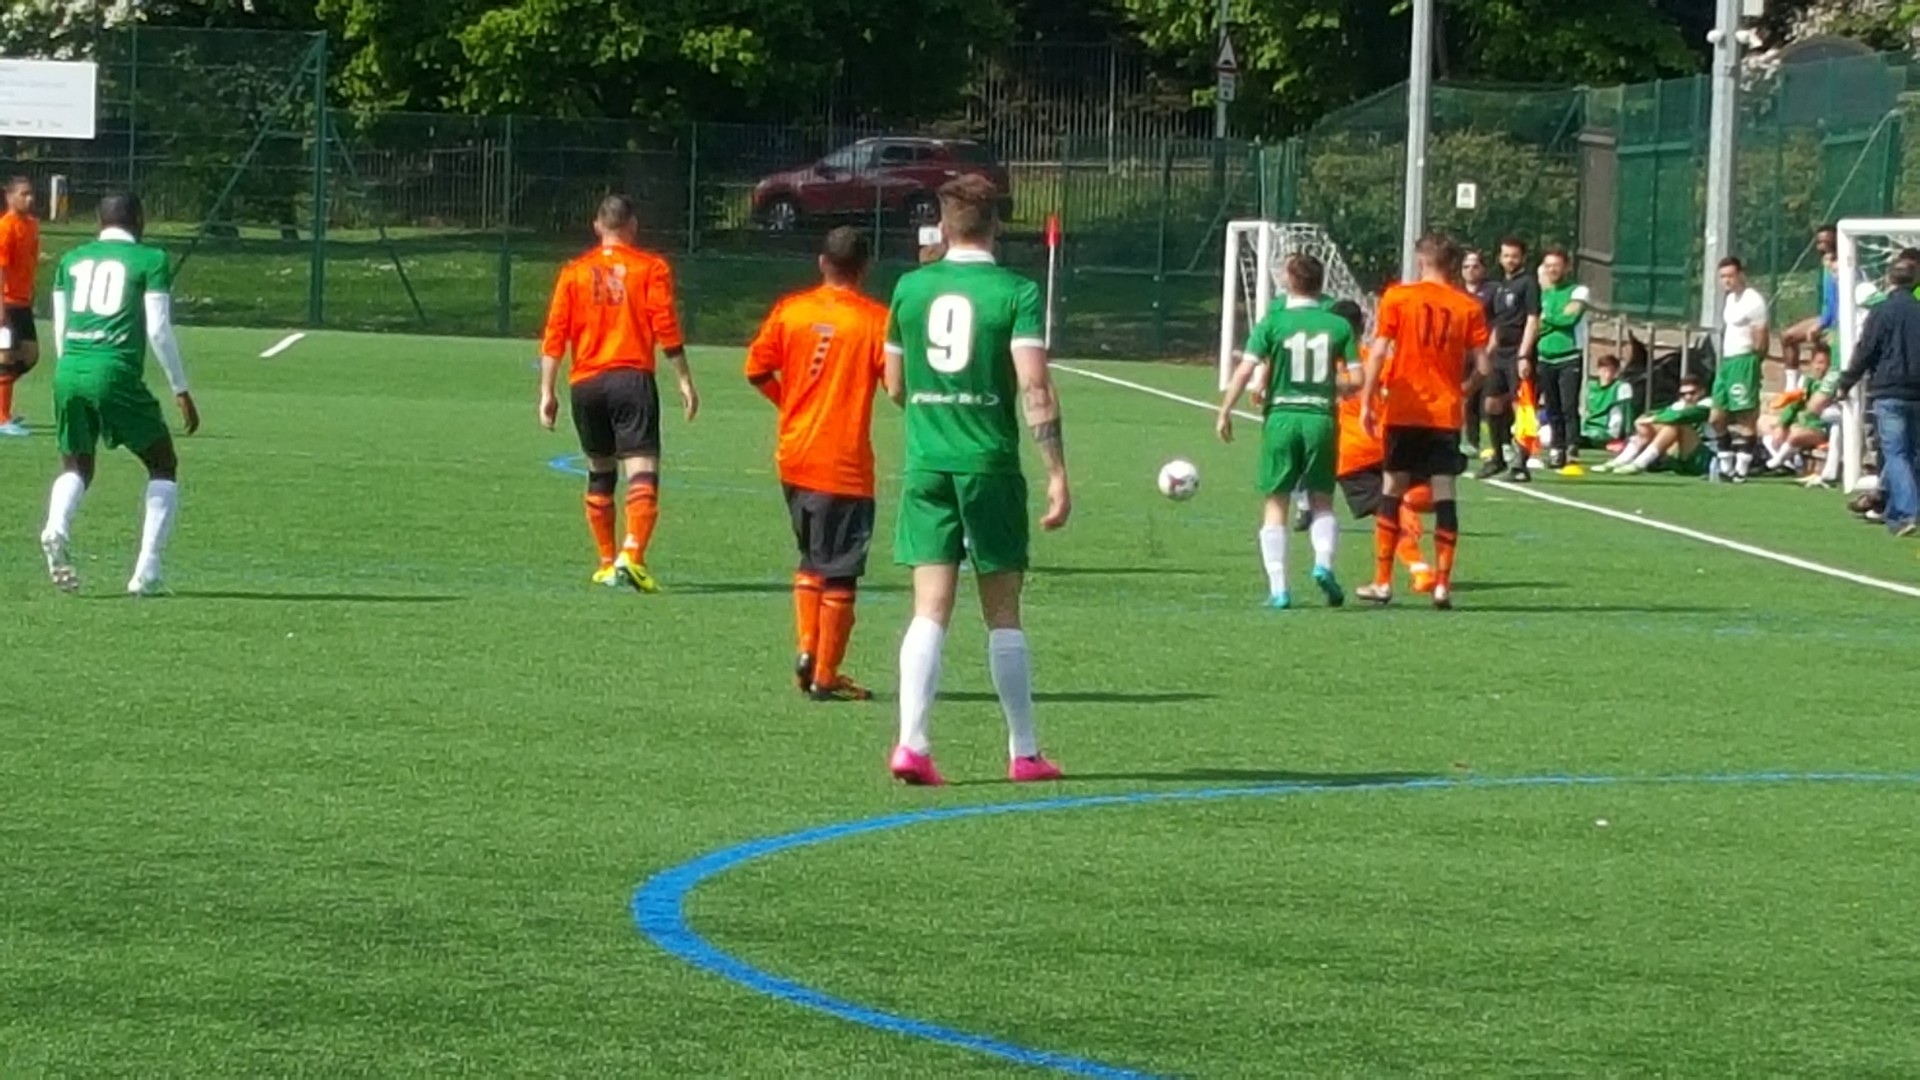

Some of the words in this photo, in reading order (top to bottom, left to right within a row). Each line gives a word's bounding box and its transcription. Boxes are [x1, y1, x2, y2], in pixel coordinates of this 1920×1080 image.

[69, 259, 125, 315] 10
[811, 322, 835, 380] 7
[927, 294, 972, 373] 9
[1283, 332, 1328, 382] 11
